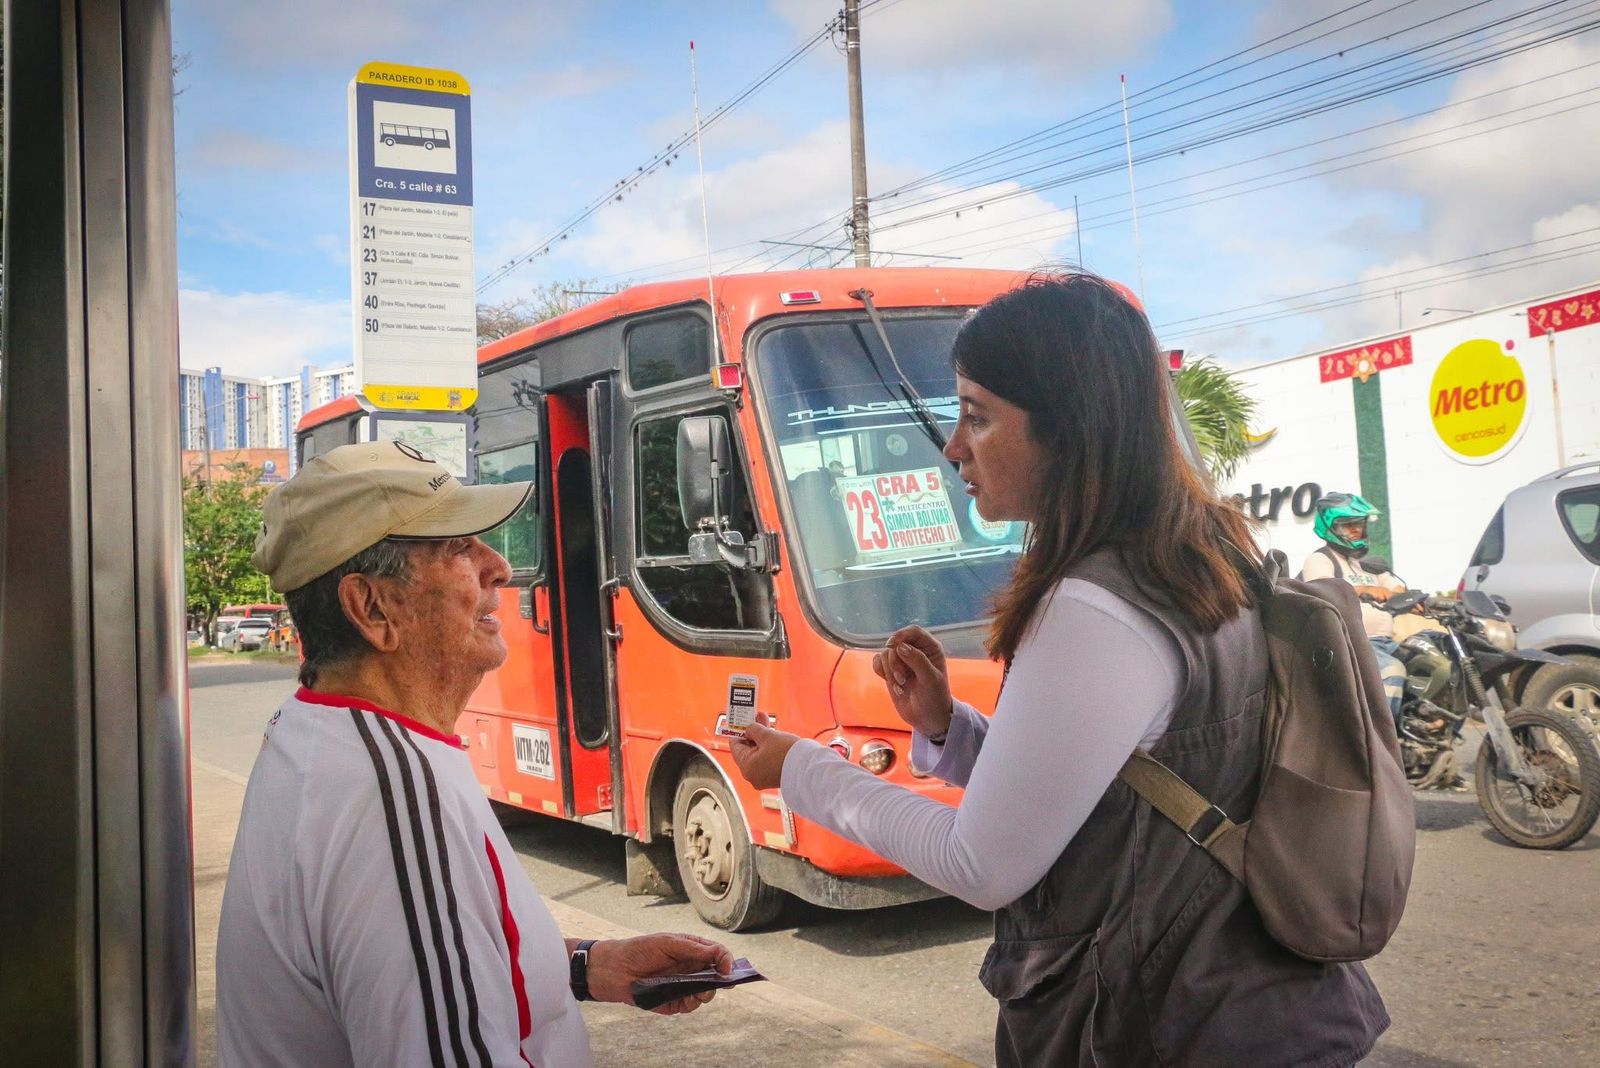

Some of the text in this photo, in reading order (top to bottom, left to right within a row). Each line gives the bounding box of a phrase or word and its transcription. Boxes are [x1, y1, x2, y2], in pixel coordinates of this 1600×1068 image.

[369, 71, 458, 88] PARADERO ID 1038
[375, 178, 397, 189] Cra.
[400, 181, 406, 190] 5
[408, 182, 433, 192] calle
[444, 185, 457, 194] 63
[363, 202, 376, 216] 17
[363, 225, 376, 240] 21
[364, 248, 377, 263] 23
[364, 272, 378, 286] 37
[364, 295, 378, 310] 40
[365, 318, 379, 333] 50
[1433, 378, 1525, 418] Metro
[1455, 423, 1506, 443] cencosud
[876, 473, 921, 497] CRA
[925, 472, 940, 490] 5
[897, 500, 946, 512] MULTICENTRO
[846, 489, 889, 551] 23
[886, 508, 952, 531] SIMON BOLIVAR
[892, 528, 946, 548] PROTECHO
